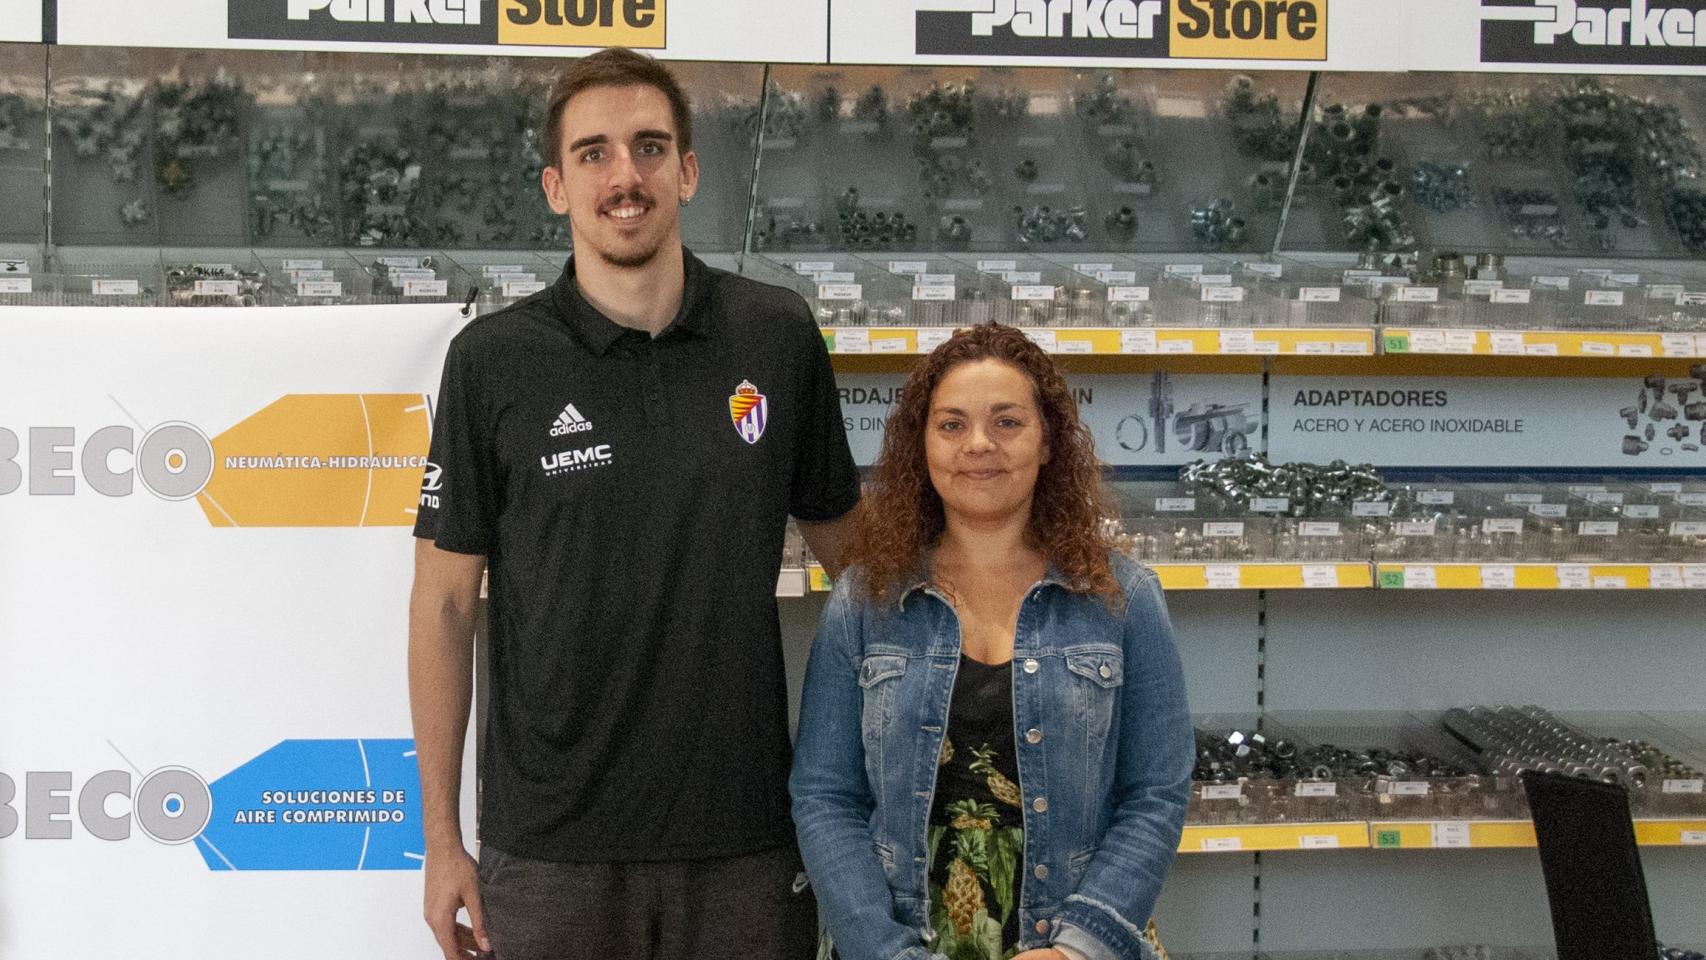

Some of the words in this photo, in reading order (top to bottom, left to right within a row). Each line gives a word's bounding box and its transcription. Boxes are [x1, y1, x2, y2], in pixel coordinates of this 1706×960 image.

[972, 0, 1162, 39] Parker
[1177, 0, 1317, 41] Store
[1294, 390, 1448, 407] ADAPTADORES
[549, 421, 593, 437] adidas
[1293, 419, 1349, 433] ACERO
[1354, 419, 1365, 433] Y
[1369, 419, 1425, 433] ACERO
[1430, 419, 1524, 433] INOXIDABLE
[225, 452, 428, 469] NEUMÁTICA-HIDRÁULICA
[540, 444, 612, 470] UEMC
[262, 790, 376, 804] SOLUCIONES
[382, 790, 405, 804] DE
[234, 810, 276, 823] AIRE
[282, 809, 405, 823] COMPRIMIDO
